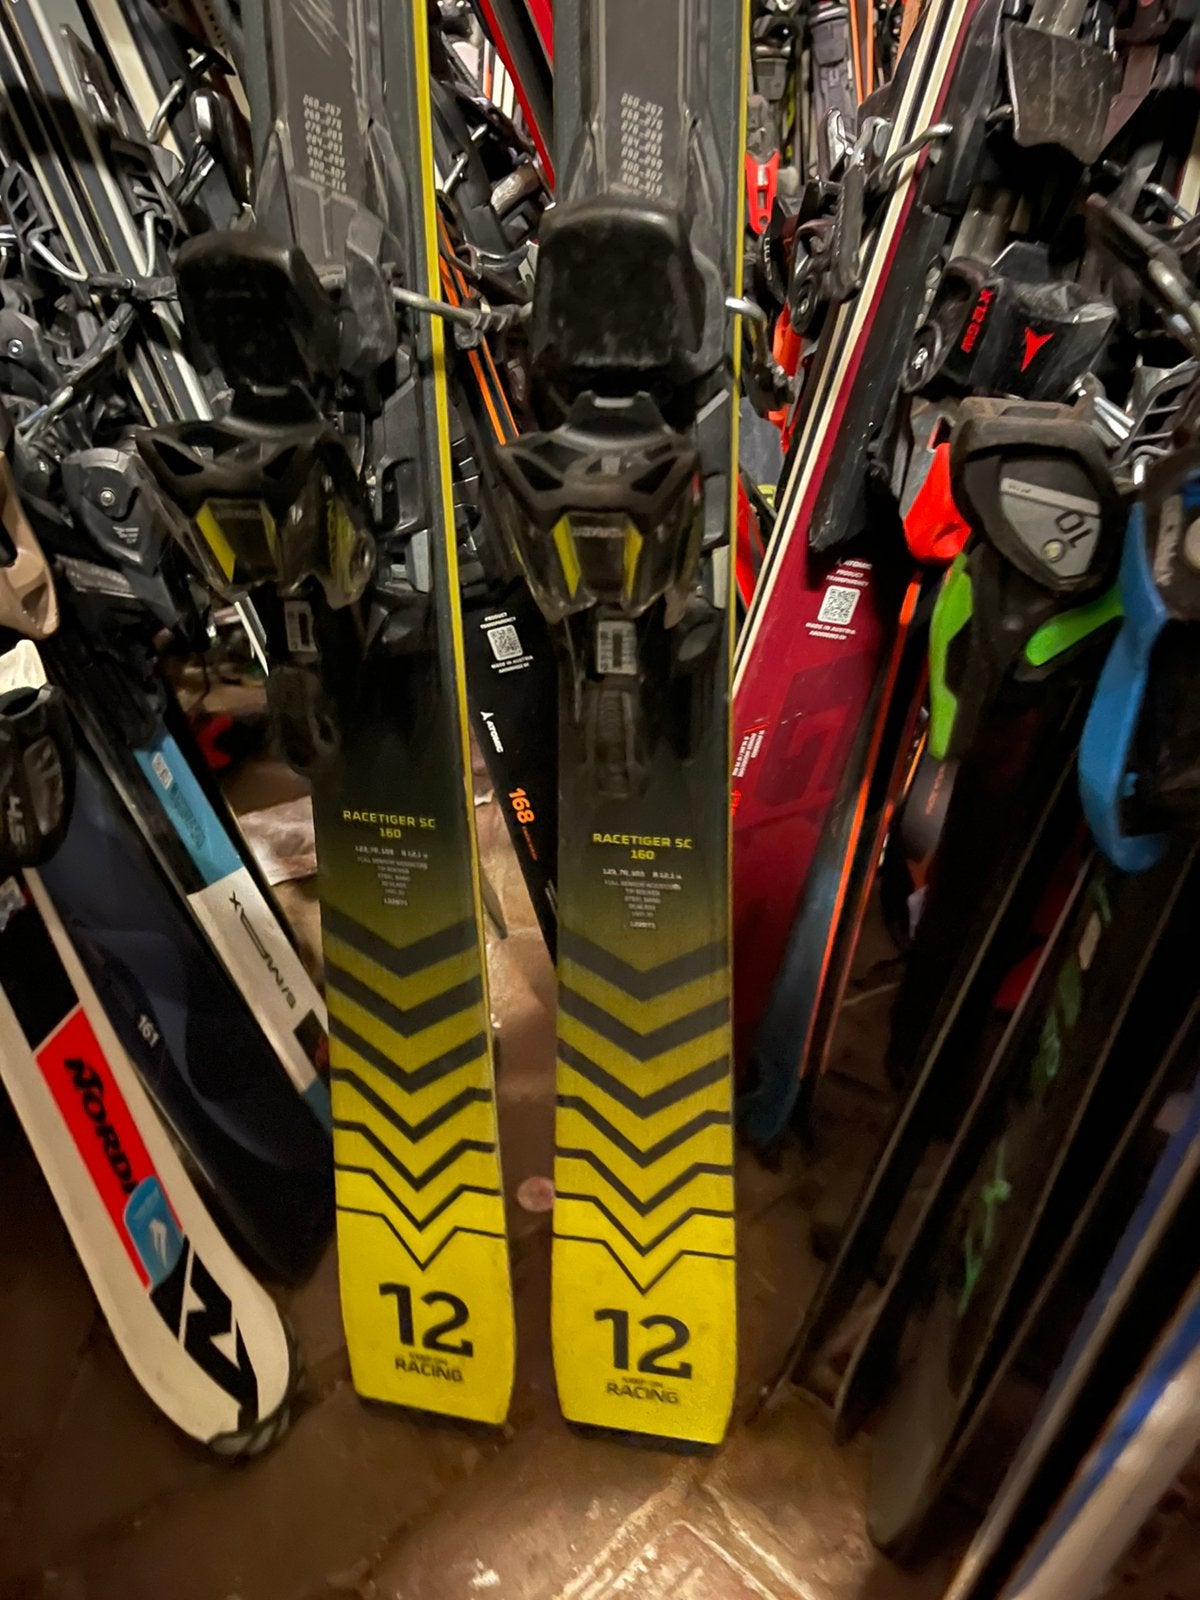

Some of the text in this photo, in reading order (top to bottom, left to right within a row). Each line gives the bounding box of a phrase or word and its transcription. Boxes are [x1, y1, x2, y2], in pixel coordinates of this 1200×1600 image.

[486, 720, 504, 753] ATOMIC
[343, 810, 436, 829] RACETIGER SC
[508, 787, 535, 824] 168
[379, 827, 402, 839] 160
[593, 833, 693, 850] RACETIGER SC
[630, 849, 656, 860] 160
[228, 890, 298, 1010] S/MAX
[138, 1014, 160, 1048] 161
[379, 1282, 474, 1358] 12
[593, 1307, 692, 1380] 12
[395, 1357, 463, 1383] RACING
[606, 1381, 680, 1405] RACING
